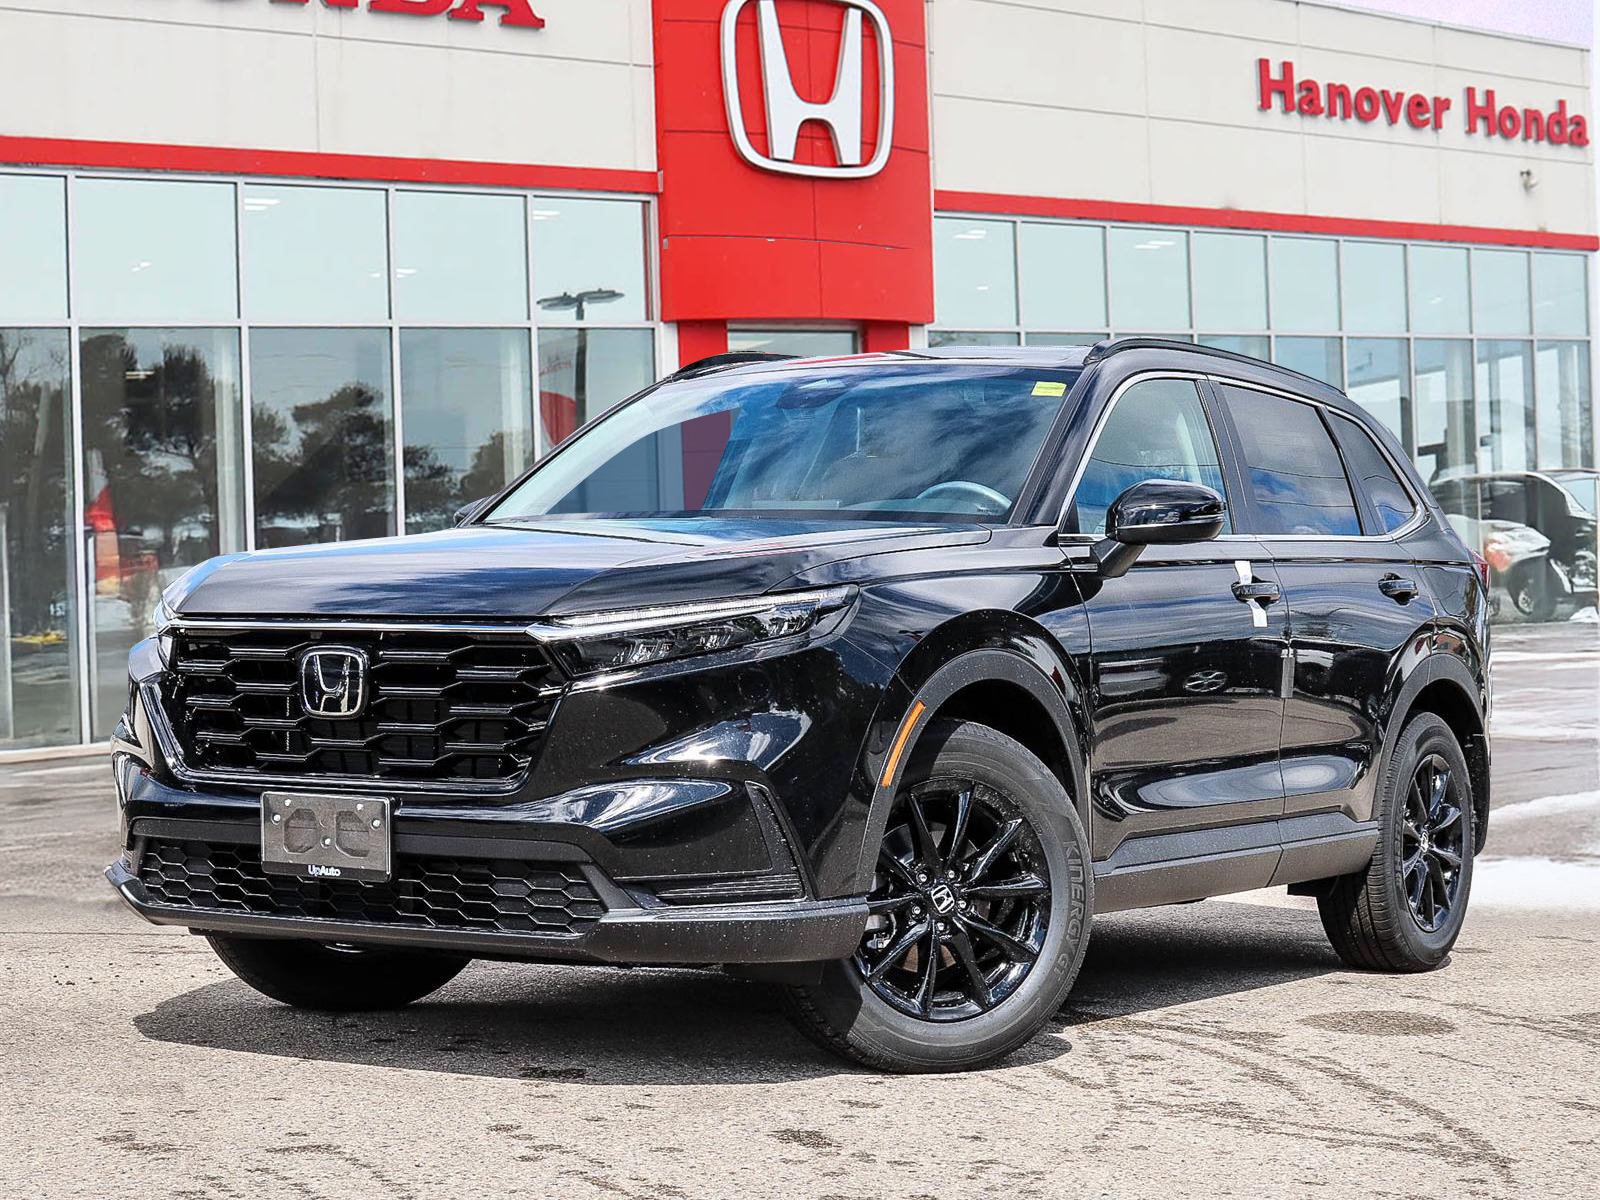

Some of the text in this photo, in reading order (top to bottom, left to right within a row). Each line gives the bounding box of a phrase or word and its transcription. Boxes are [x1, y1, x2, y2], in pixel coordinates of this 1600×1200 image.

[1257, 57, 1590, 147] Hanover Honda
[307, 864, 342, 877] UpAuto
[1063, 840, 1086, 955] KINERGY
